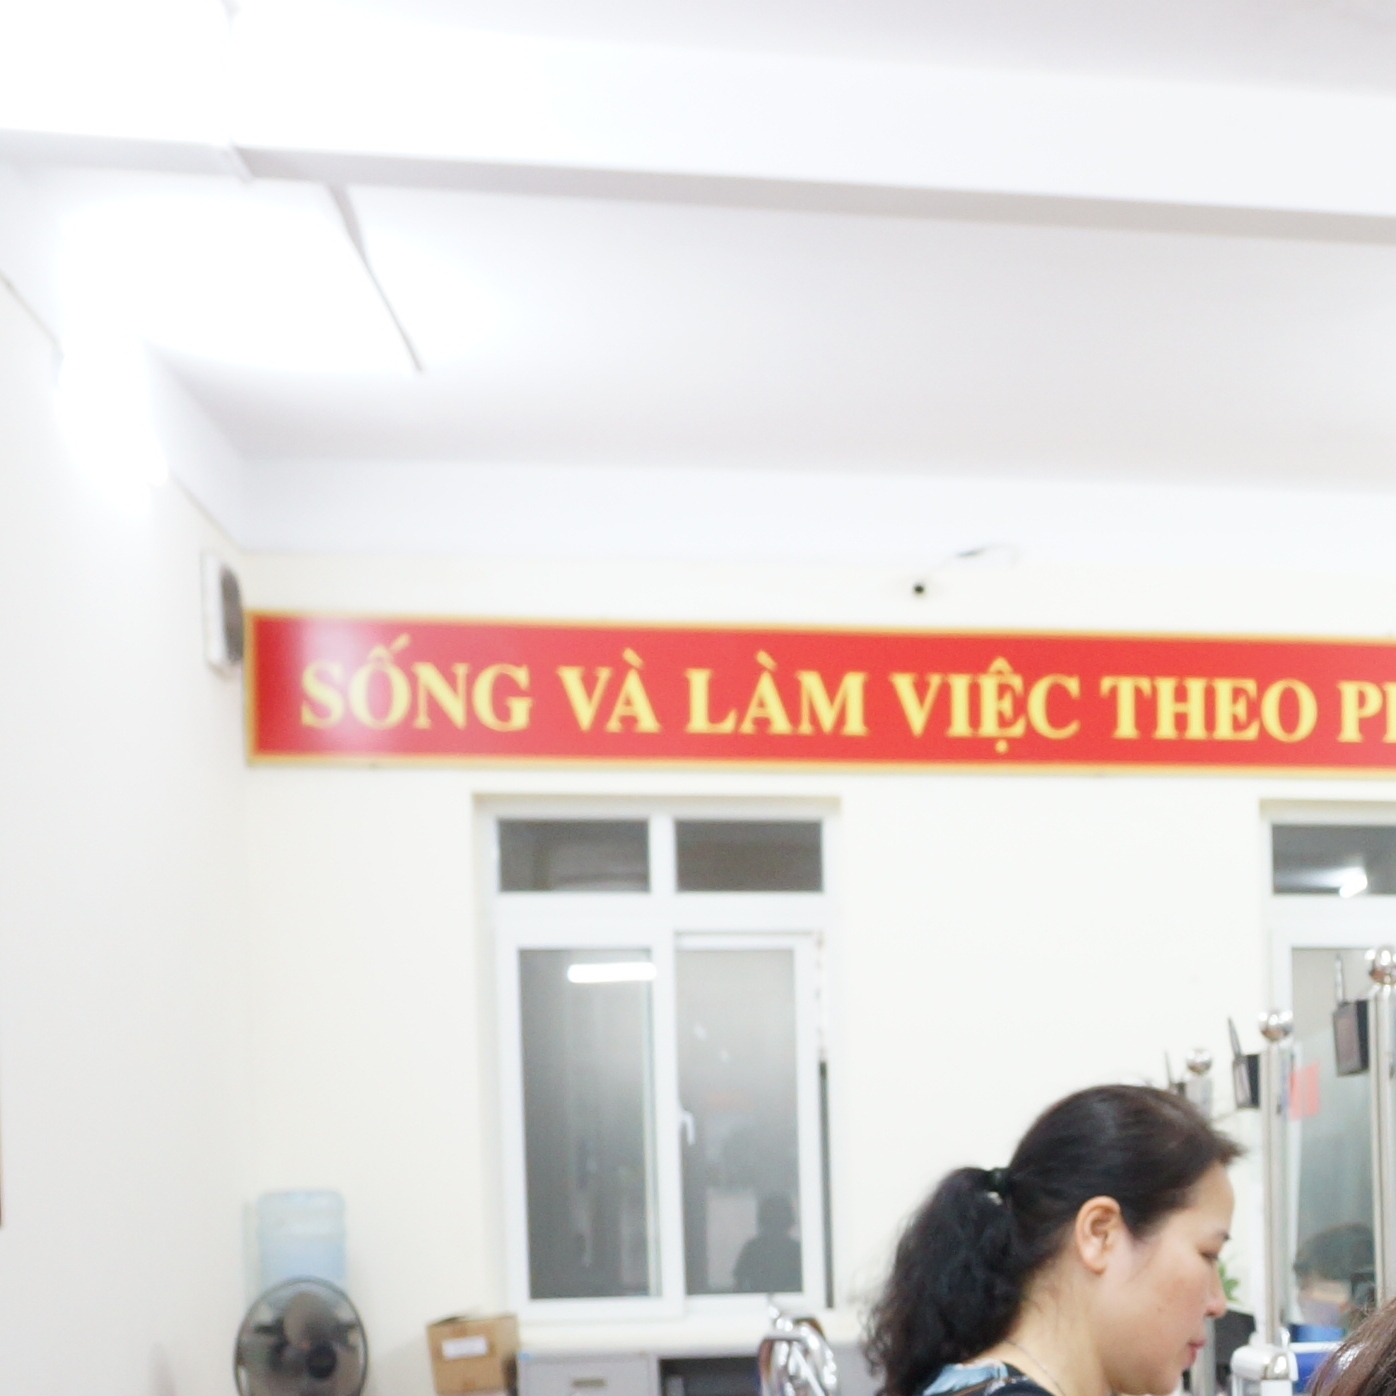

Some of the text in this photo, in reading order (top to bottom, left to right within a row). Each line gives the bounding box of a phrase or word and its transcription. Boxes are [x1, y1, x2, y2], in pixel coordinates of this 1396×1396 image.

[302, 632, 533, 732] SỐNG
[556, 646, 662, 734] VÀ
[685, 649, 869, 737] LÀM
[889, 655, 1082, 755] VIỆC
[1100, 675, 1319, 743] THEO
